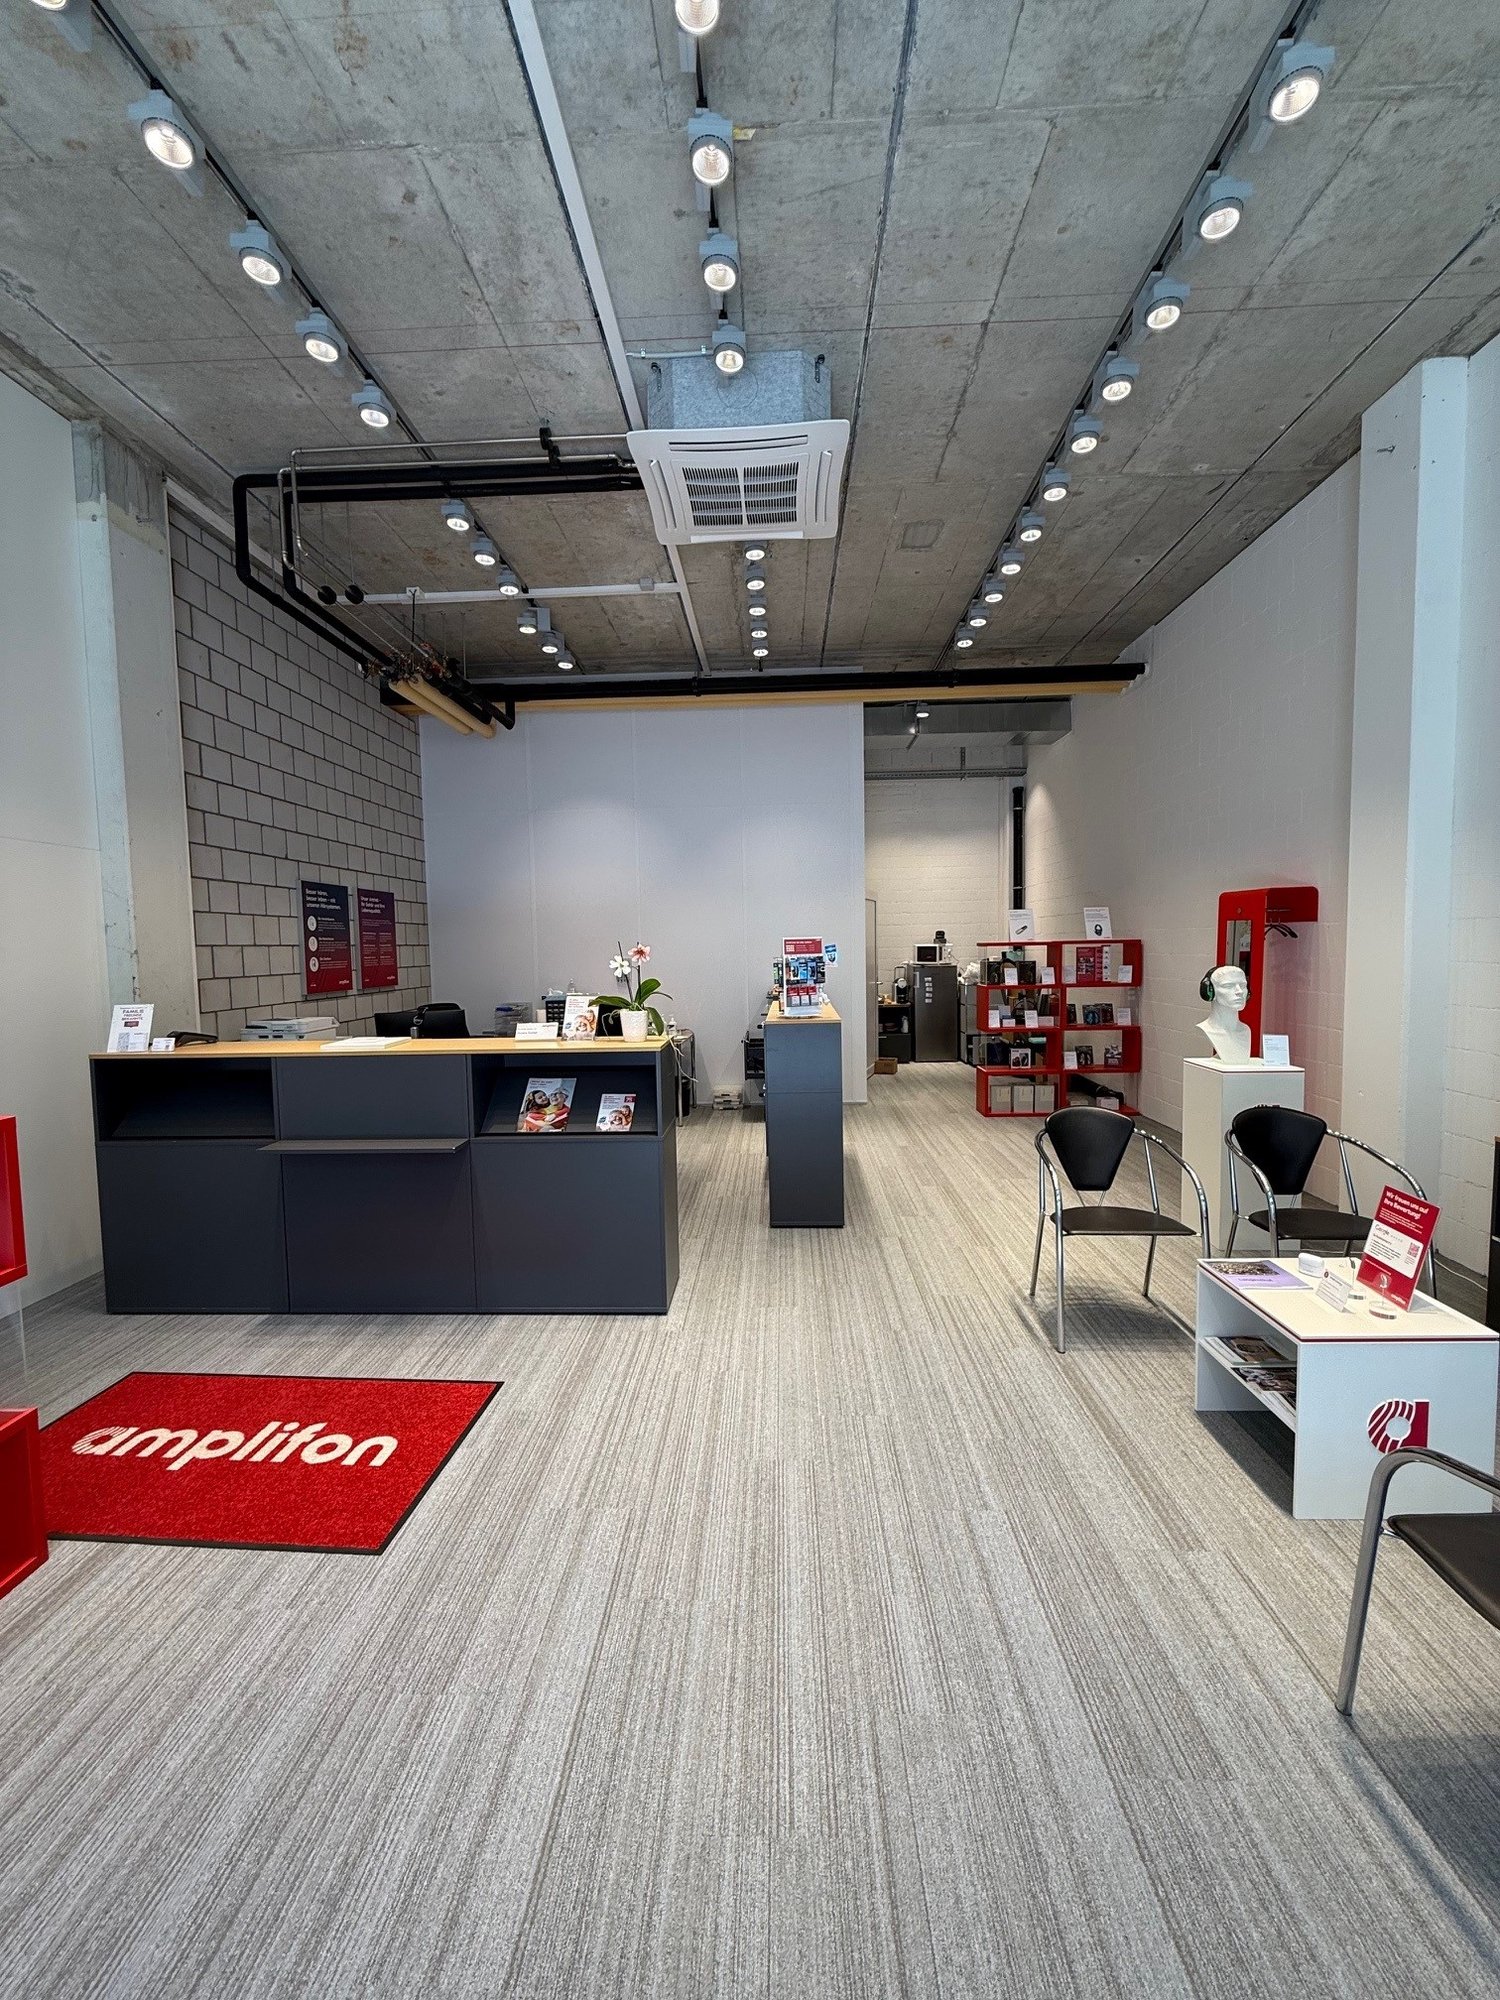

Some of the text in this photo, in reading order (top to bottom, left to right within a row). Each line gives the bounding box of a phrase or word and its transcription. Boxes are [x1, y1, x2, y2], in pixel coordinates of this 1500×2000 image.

[1386, 1190, 1429, 1214] Wir freuen uns auf
[71, 1421, 398, 1471] amplifon
